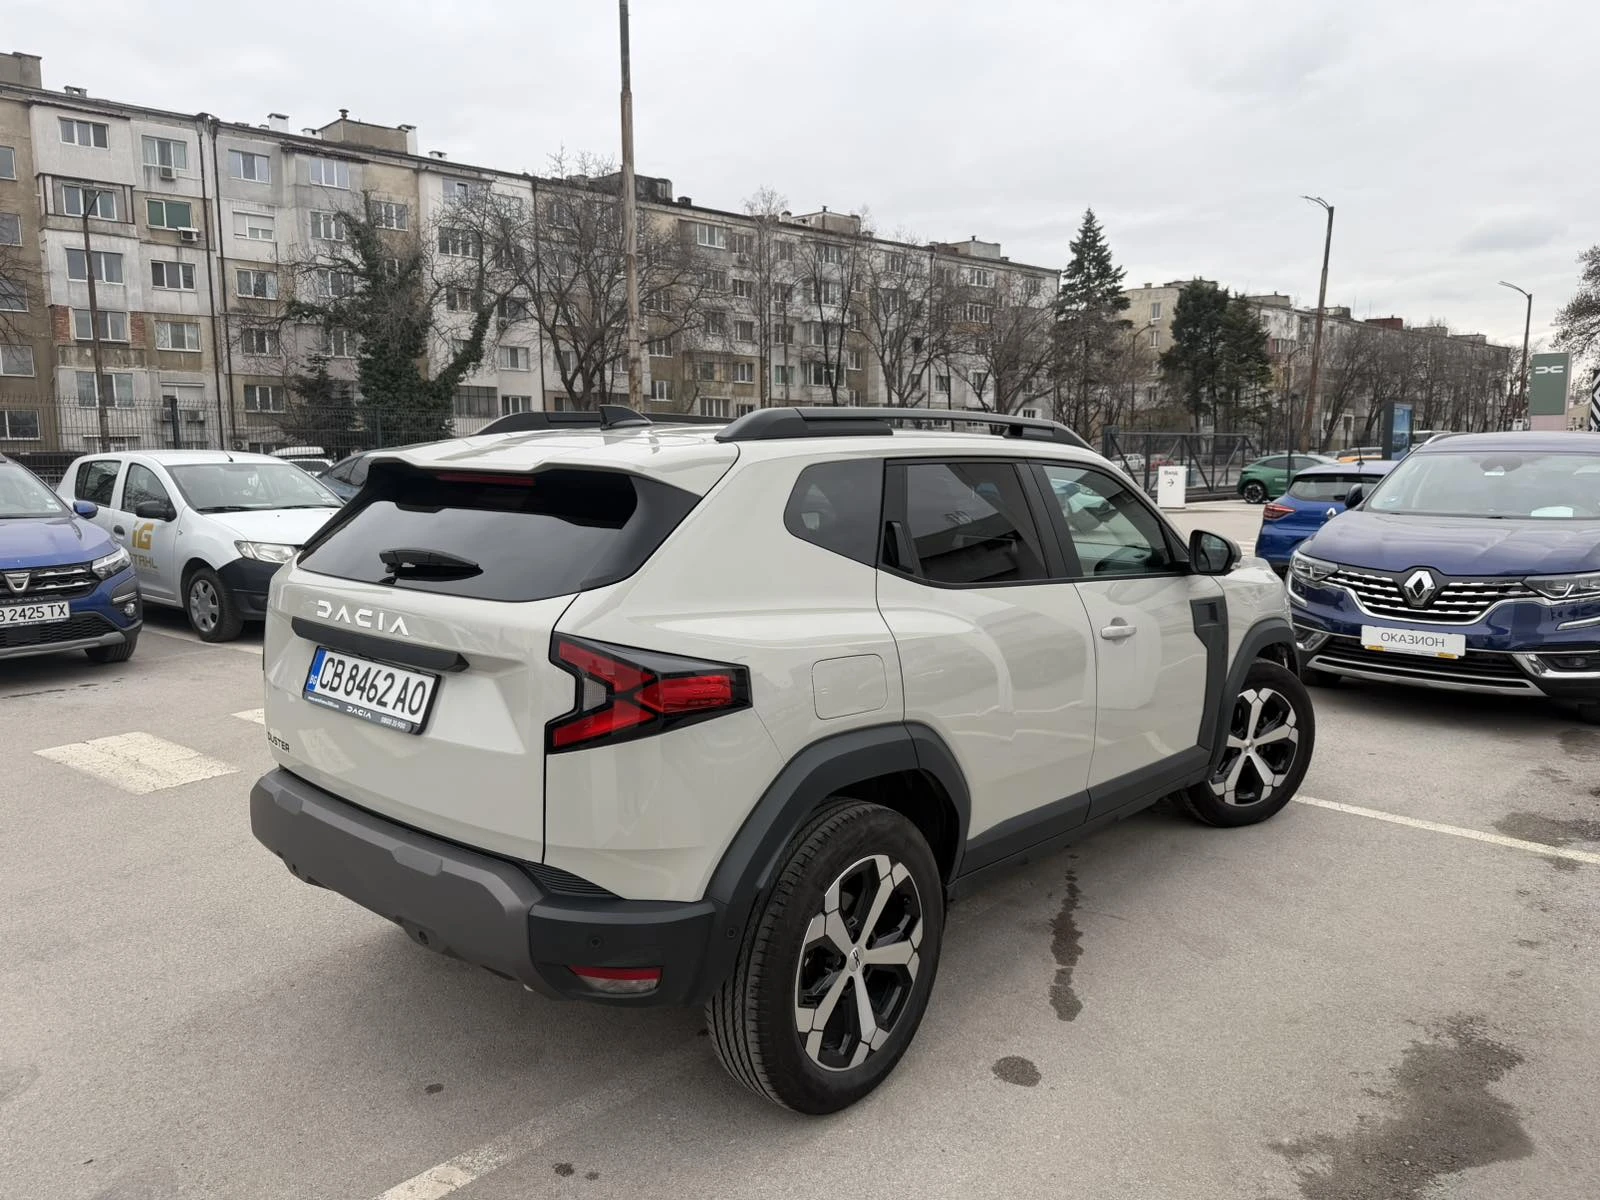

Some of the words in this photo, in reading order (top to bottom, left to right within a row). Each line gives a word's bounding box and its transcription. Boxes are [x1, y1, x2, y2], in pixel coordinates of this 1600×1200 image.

[9, 606, 45, 621] 2425
[47, 603, 67, 617] TX
[316, 599, 409, 636] DACIA
[1380, 632, 1445, 647] ОКАЗИОН
[310, 674, 319, 685] BG
[319, 657, 346, 692] CB
[344, 664, 395, 708] 8462
[346, 705, 372, 719] DACIA
[267, 731, 290, 753] DUSTER
